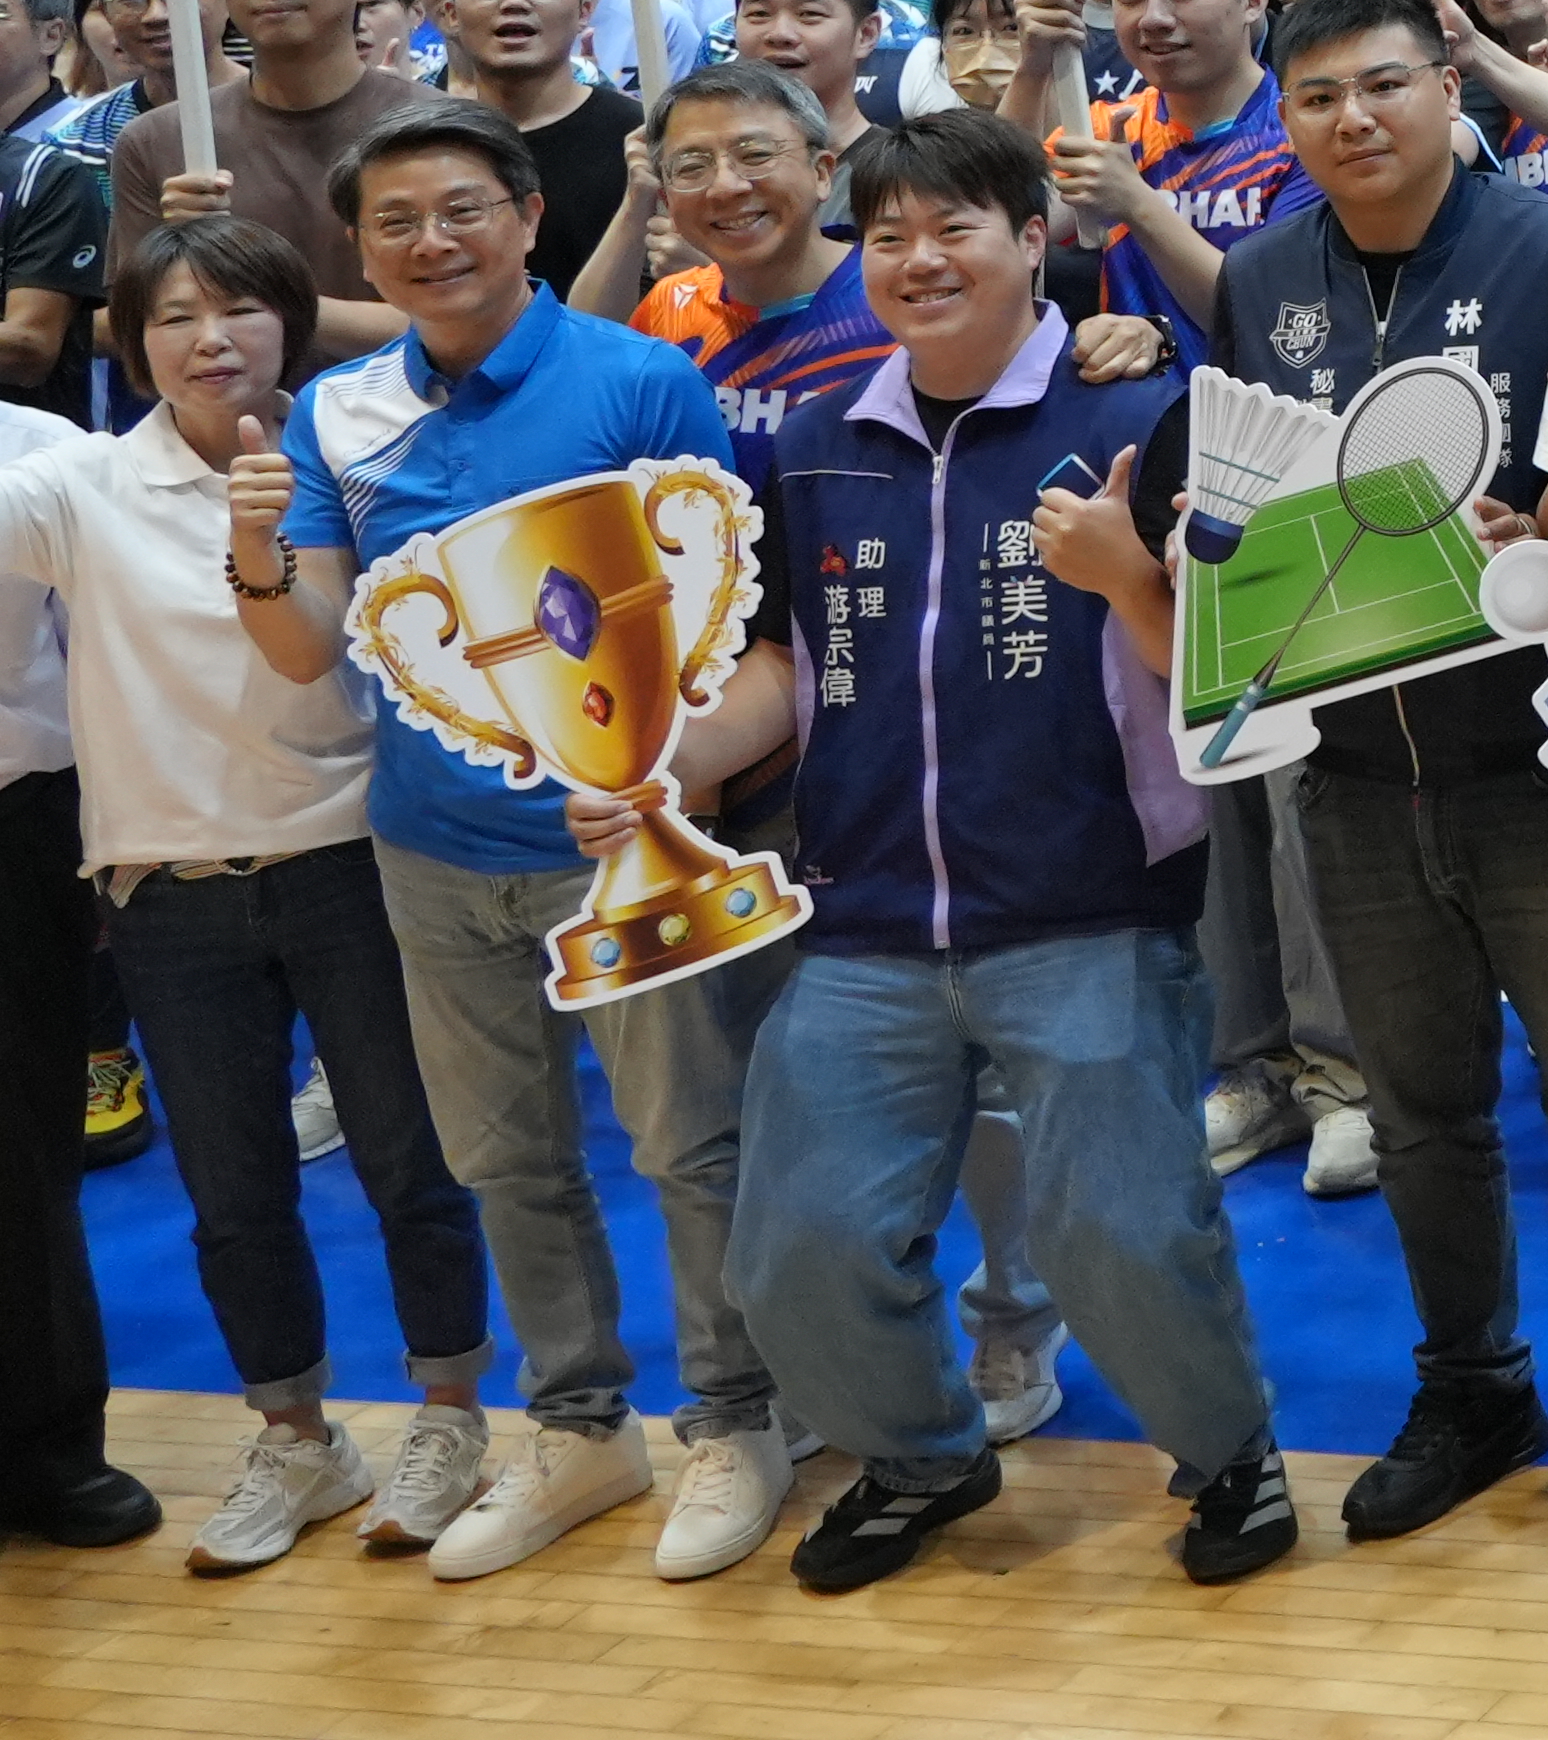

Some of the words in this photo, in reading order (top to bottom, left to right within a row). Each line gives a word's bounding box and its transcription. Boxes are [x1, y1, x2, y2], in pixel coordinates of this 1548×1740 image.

[1291, 312, 1317, 328] GO
[855, 538, 886, 618] 助理
[997, 519, 1048, 680] 劉美芳
[820, 584, 856, 708] 游宗偉
